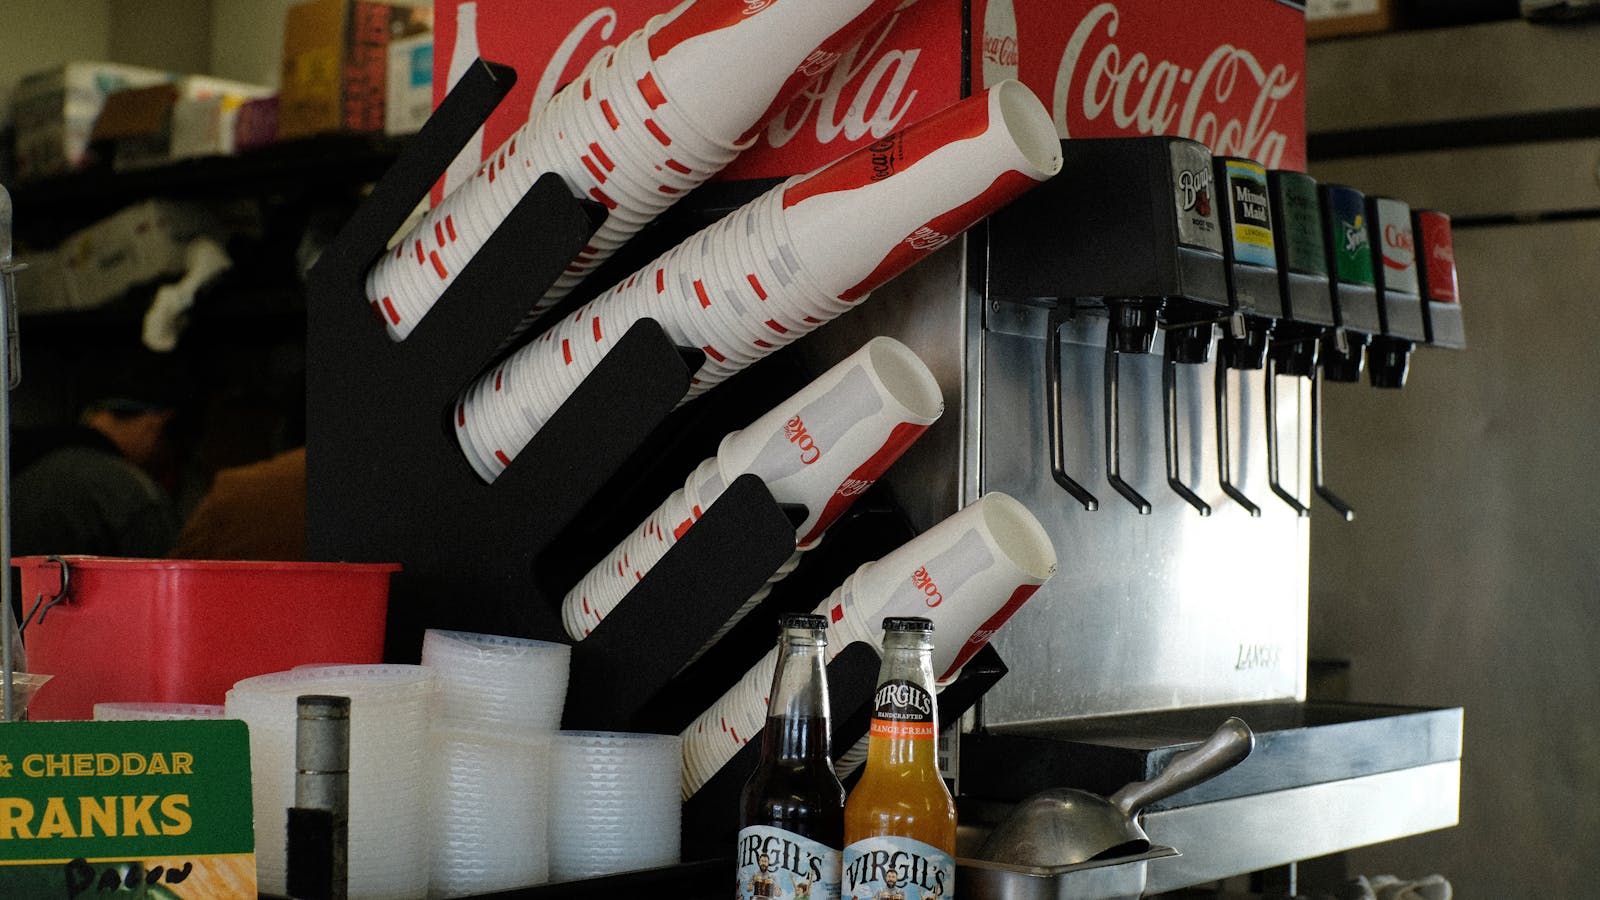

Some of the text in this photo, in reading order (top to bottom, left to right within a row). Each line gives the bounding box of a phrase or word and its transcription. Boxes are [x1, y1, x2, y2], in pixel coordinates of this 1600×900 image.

[1236, 185, 1267, 208] Minute
[1243, 202, 1267, 222] Maid
[787, 415, 820, 465] Coke
[914, 565, 943, 608] Coke
[874, 684, 931, 715] VIRGIL'S
[877, 711, 924, 720] HANDCRAFTED
[901, 725, 933, 736] CREAM
[22, 751, 194, 778] CHEDDAR
[846, 849, 945, 894] VIRGIL'S
